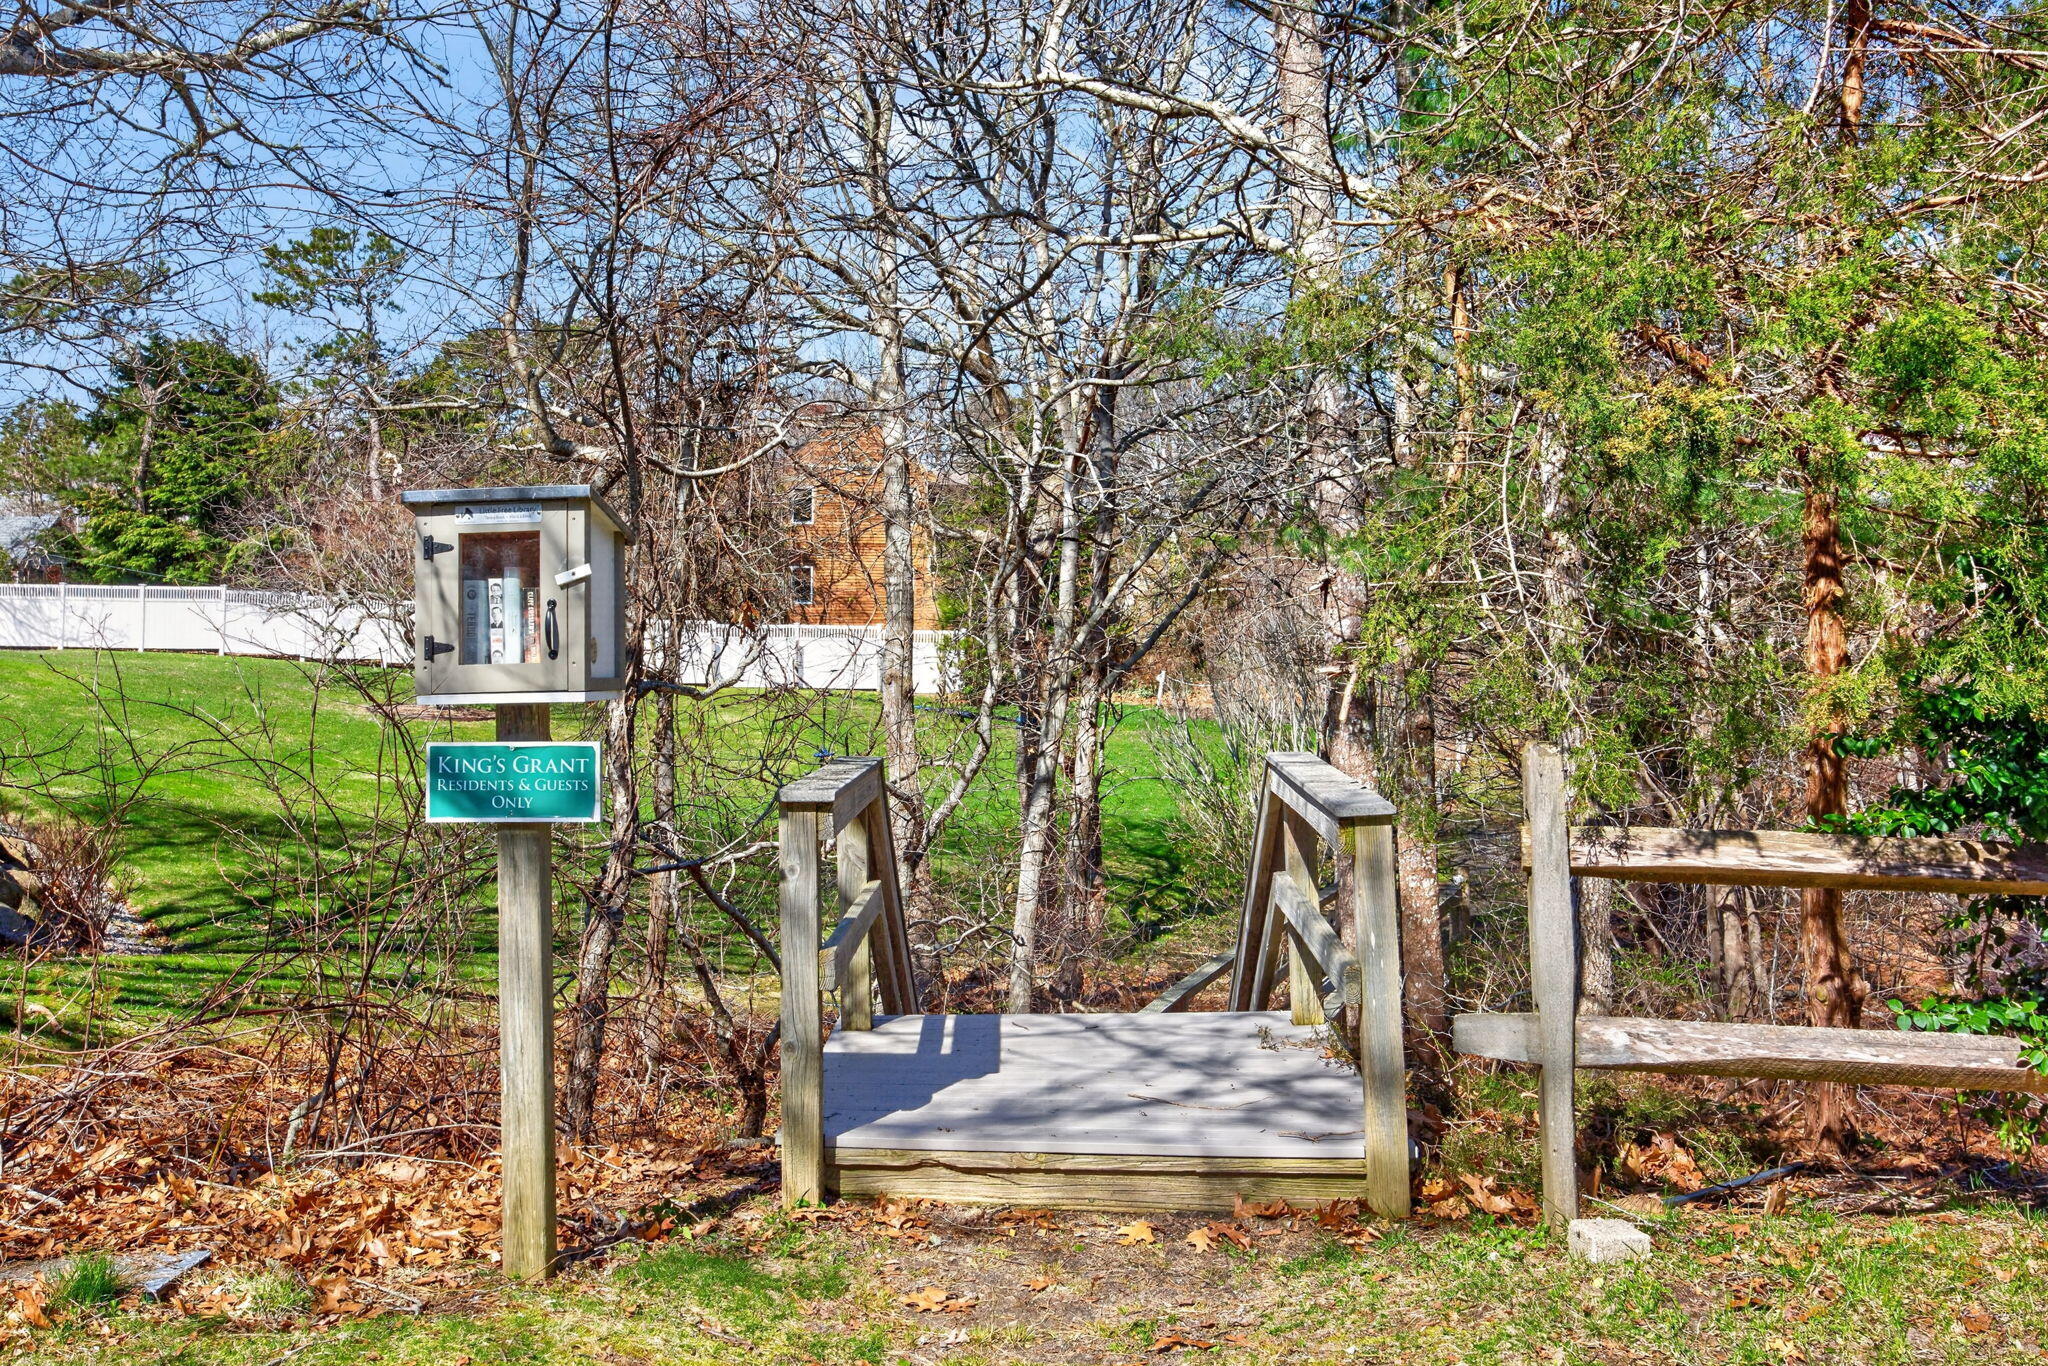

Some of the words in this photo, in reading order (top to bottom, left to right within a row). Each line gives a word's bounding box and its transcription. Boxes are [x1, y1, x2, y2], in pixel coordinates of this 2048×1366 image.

[513, 506, 536, 515] Library
[438, 754, 506, 774] KING'S
[513, 755, 589, 774] GRANT
[437, 778, 514, 791] RESIDENTS
[519, 778, 531, 791] &
[534, 778, 588, 791] GUESTS
[491, 795, 533, 808] ONLY
